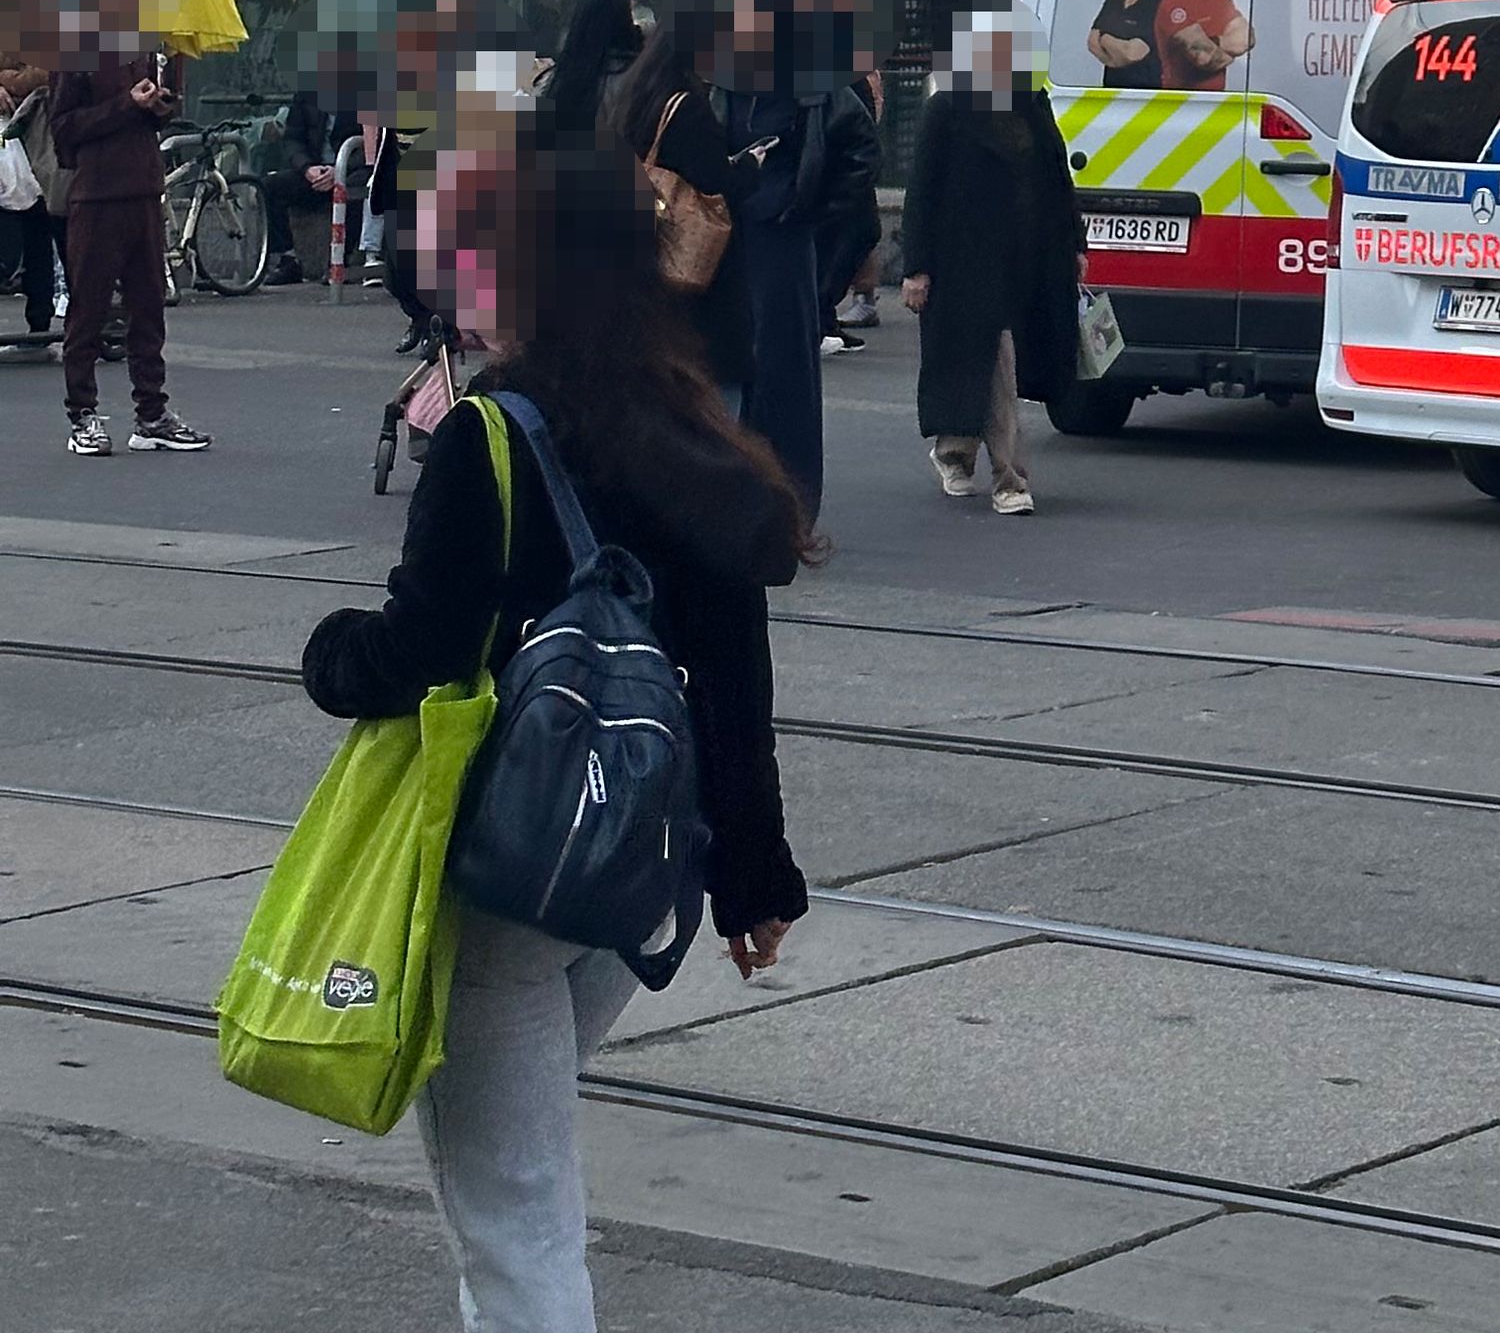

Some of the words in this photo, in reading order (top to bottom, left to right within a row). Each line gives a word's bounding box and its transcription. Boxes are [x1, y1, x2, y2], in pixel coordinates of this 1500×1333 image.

[1415, 35, 1477, 81] 144
[1107, 217, 1151, 241] 1636
[1155, 219, 1180, 242] RD
